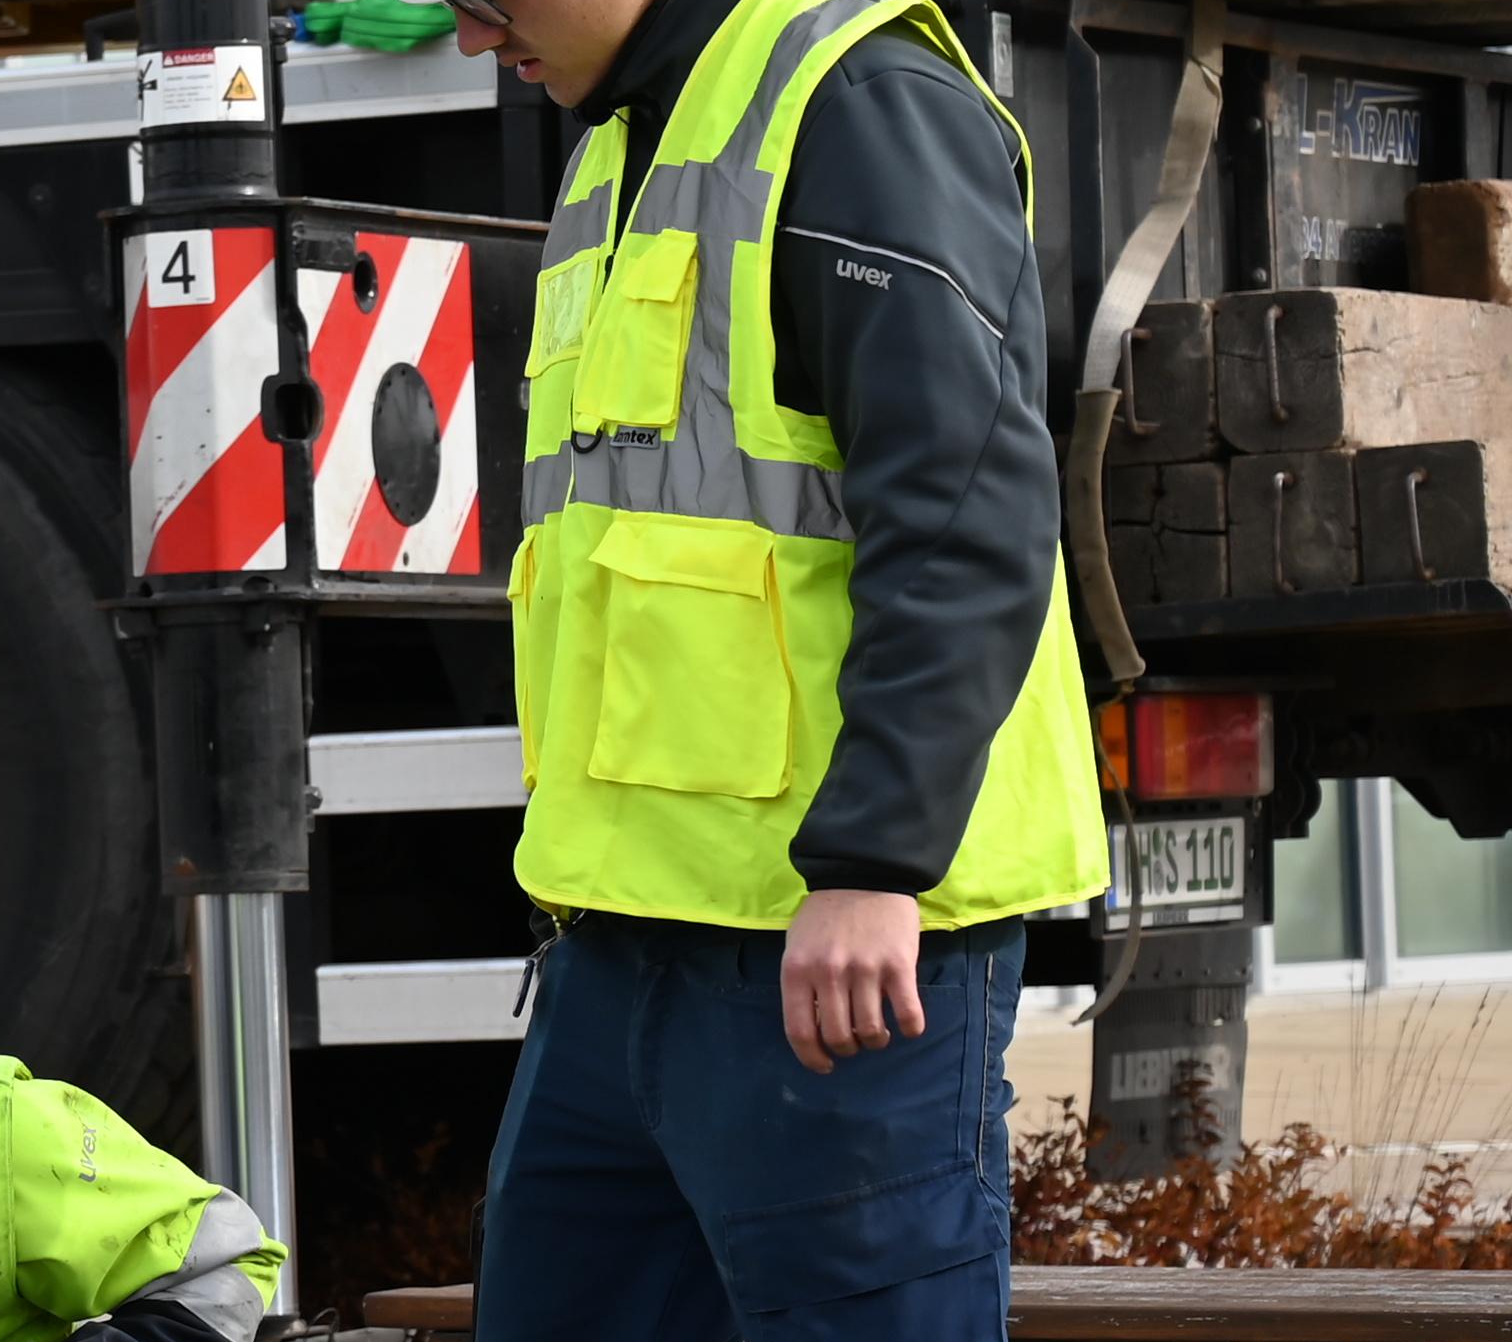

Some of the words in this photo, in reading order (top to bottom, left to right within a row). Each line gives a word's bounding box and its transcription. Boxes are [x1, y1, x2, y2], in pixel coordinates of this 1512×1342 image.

[161, 240, 196, 295] 4
[836, 258, 893, 291] uvex
[1165, 828, 1179, 894] S
[1185, 825, 1235, 892] 110
